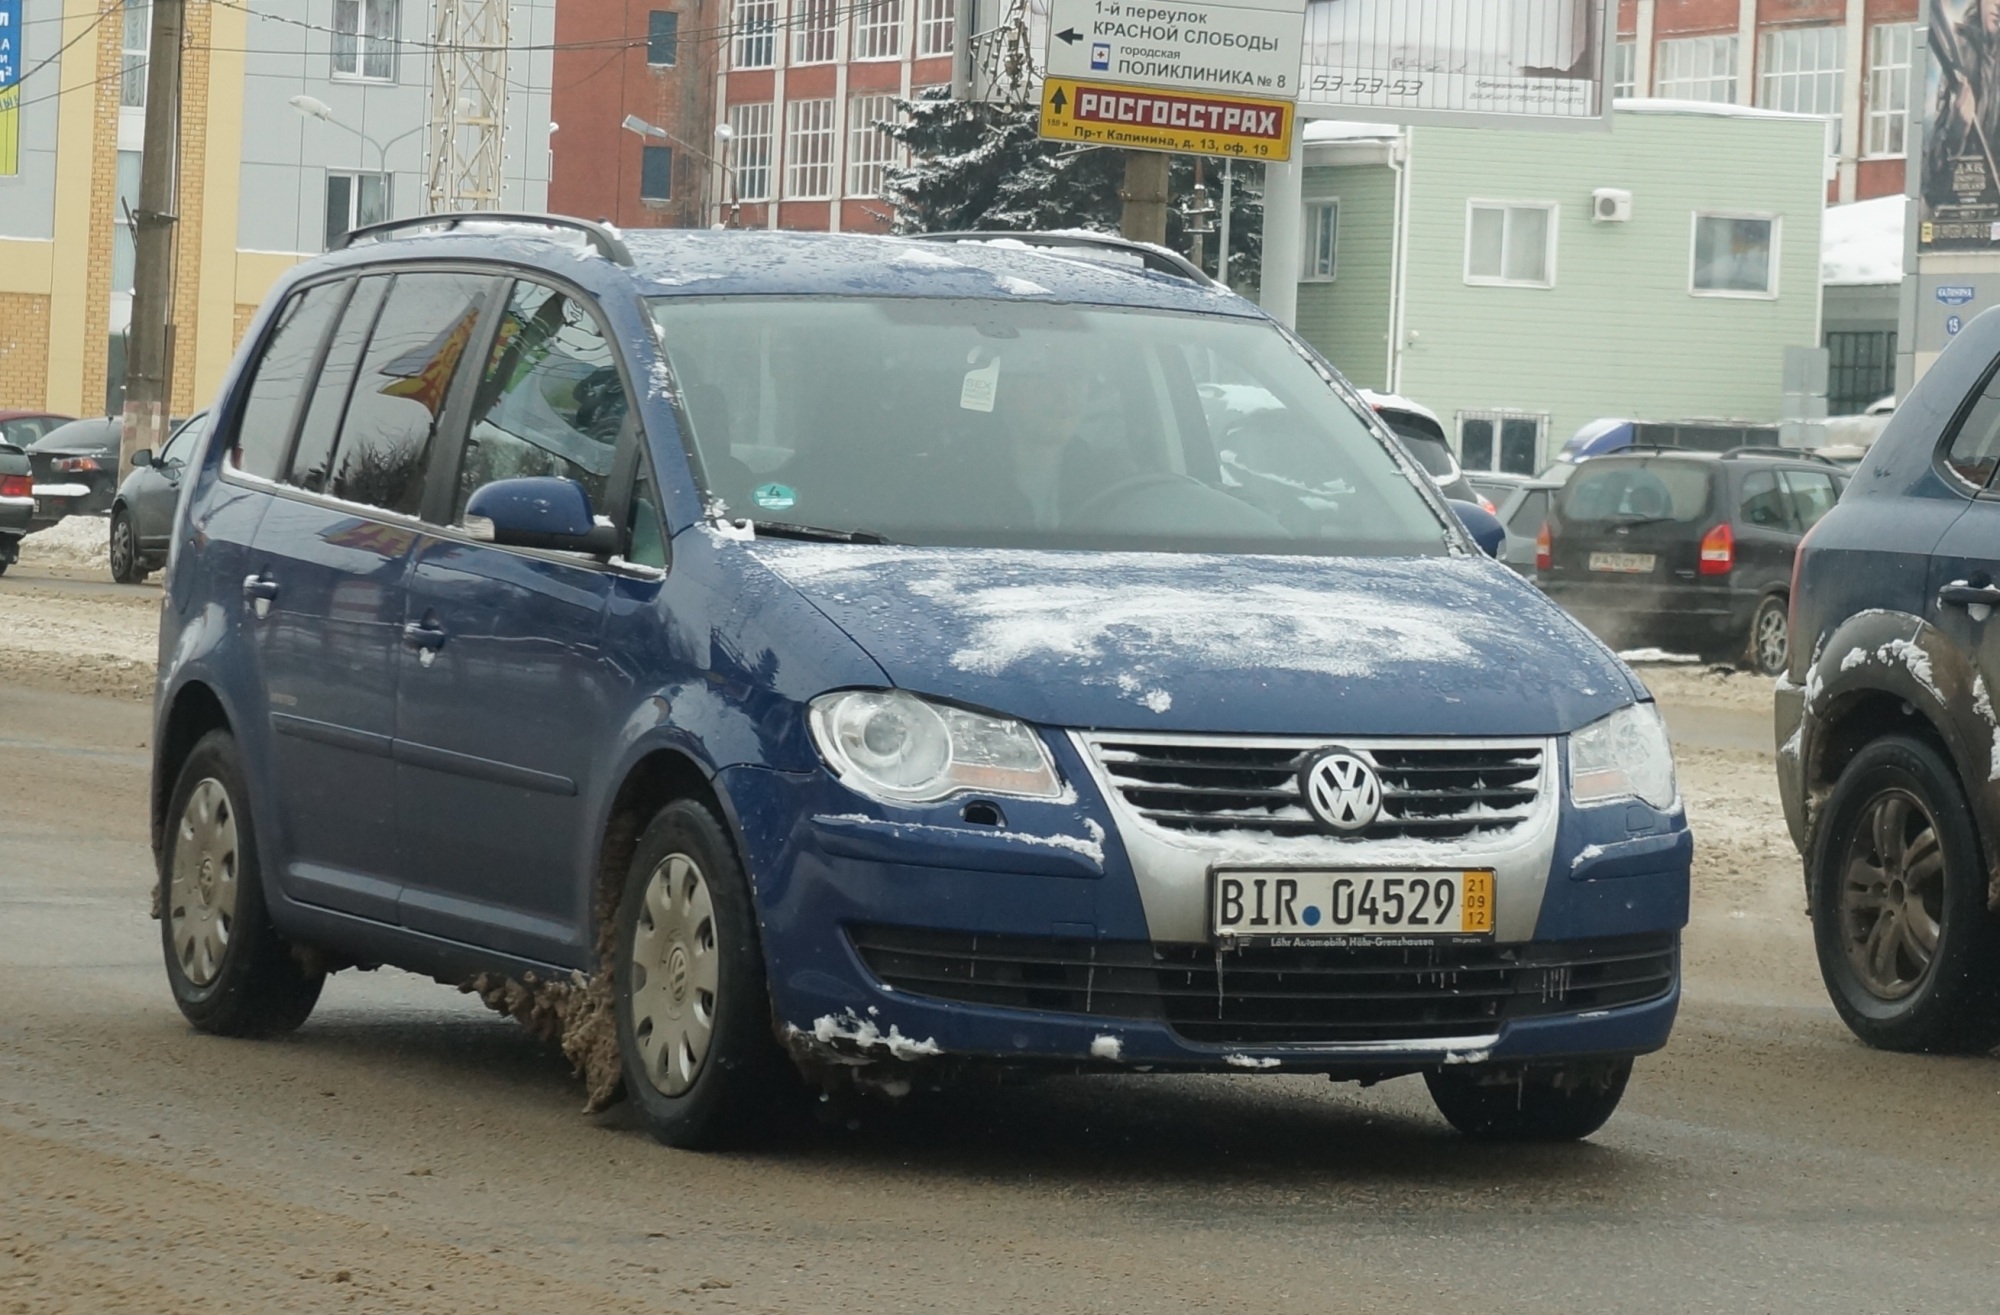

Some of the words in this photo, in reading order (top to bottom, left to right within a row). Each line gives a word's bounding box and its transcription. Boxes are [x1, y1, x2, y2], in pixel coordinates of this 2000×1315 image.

[1095, 2, 1121, 17] 1-й
[1126, 4, 1208, 25] переулок
[1093, 20, 1179, 43] КРАСНОЙ
[1184, 29, 1279, 52] СЛОБОДЫ
[1120, 46, 1181, 60] городская
[1118, 59, 1254, 86] ПОЛИКЛИНИКА
[1277, 75, 1286, 89] 8
[1311, 75, 1423, 96] 53-53-53
[1080, 93, 1277, 135] РОСГОССТРАХ
[1074, 126, 1103, 141] Пр-т
[1107, 128, 1178, 148] Калинина,
[1182, 138, 1194, 150] д.
[1200, 139, 1219, 152] 13,
[1224, 141, 1248, 155] оф.
[1254, 145, 1269, 155] 19
[768, 485, 781, 497] 4
[1467, 879, 1485, 892] 21
[1221, 878, 1298, 926] BIR
[1332, 878, 1455, 926] 04529
[1467, 895, 1485, 908] 09
[1468, 911, 1485, 925] 12
